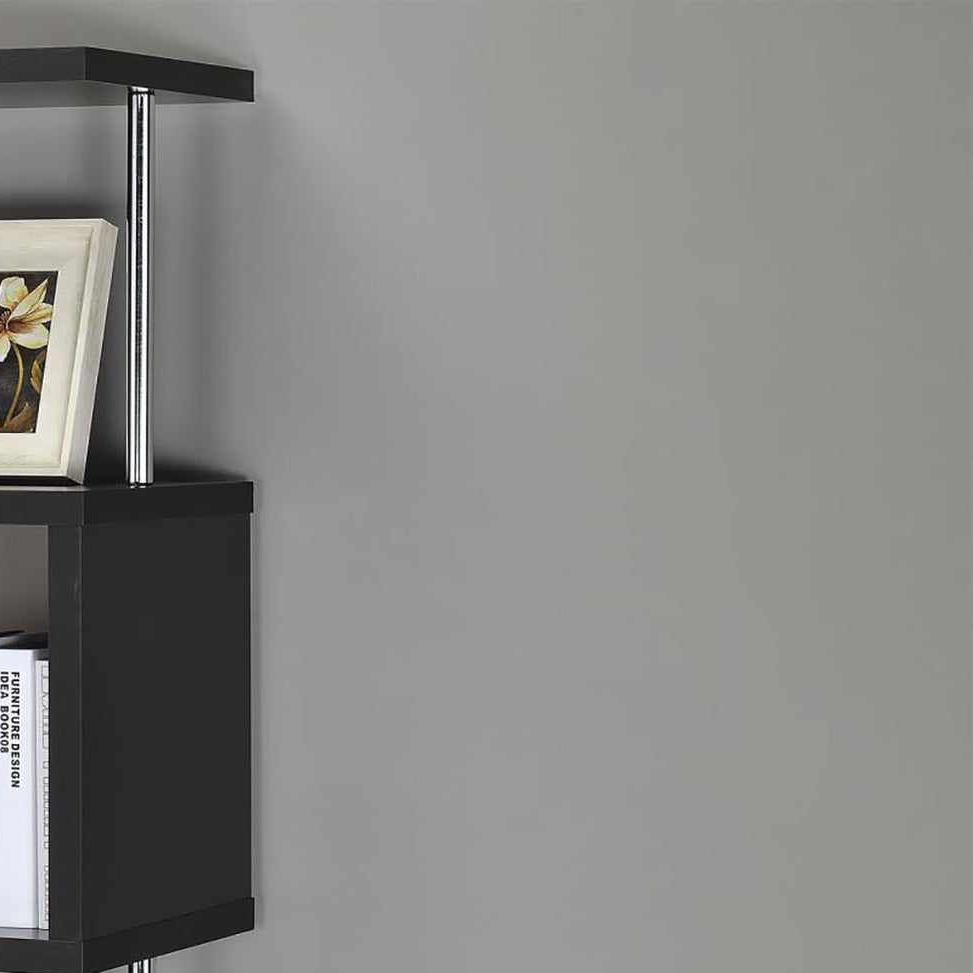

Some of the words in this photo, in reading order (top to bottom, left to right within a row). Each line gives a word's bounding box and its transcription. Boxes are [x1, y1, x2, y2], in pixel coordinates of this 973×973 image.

[0, 671, 9, 699] IDEA
[11, 671, 20, 740] FURNITURE
[0, 705, 9, 753] BOOK08
[11, 743, 20, 788] DESIGN
